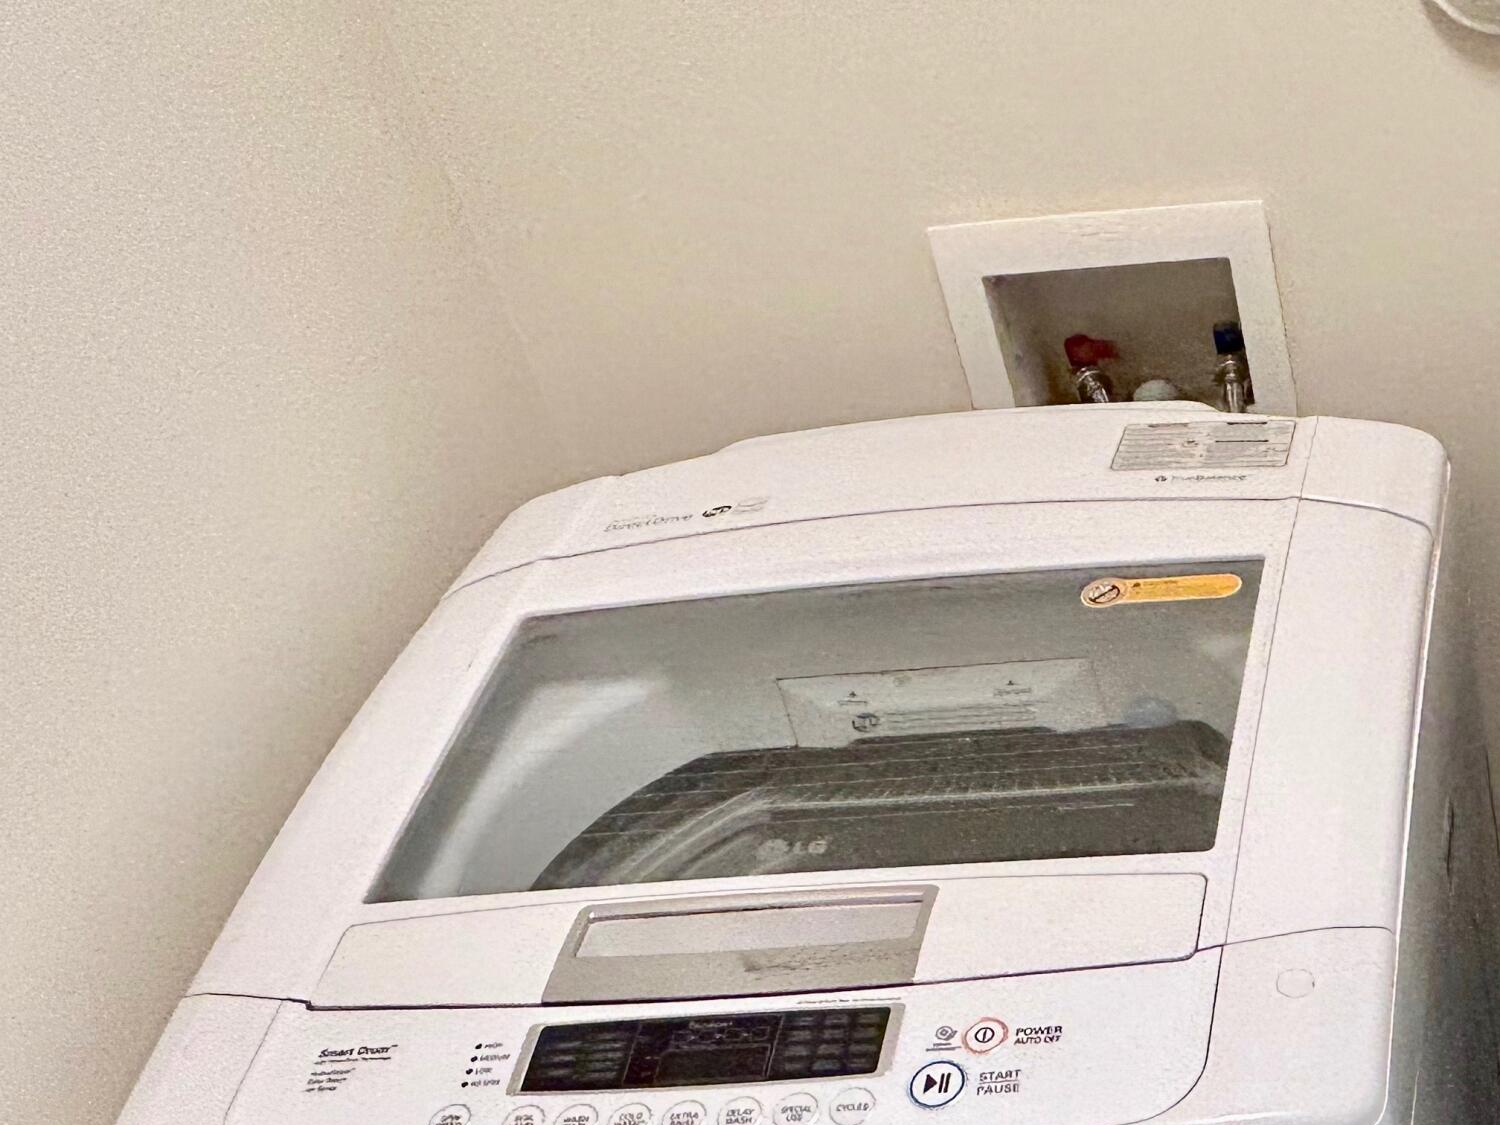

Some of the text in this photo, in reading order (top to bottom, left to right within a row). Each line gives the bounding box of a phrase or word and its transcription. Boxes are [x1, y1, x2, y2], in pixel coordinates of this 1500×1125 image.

[1015, 1025, 1063, 1037] POWER
[1013, 1036, 1042, 1045] AUTO
[978, 1069, 1022, 1082] START
[976, 1083, 1021, 1096] PAUSE
